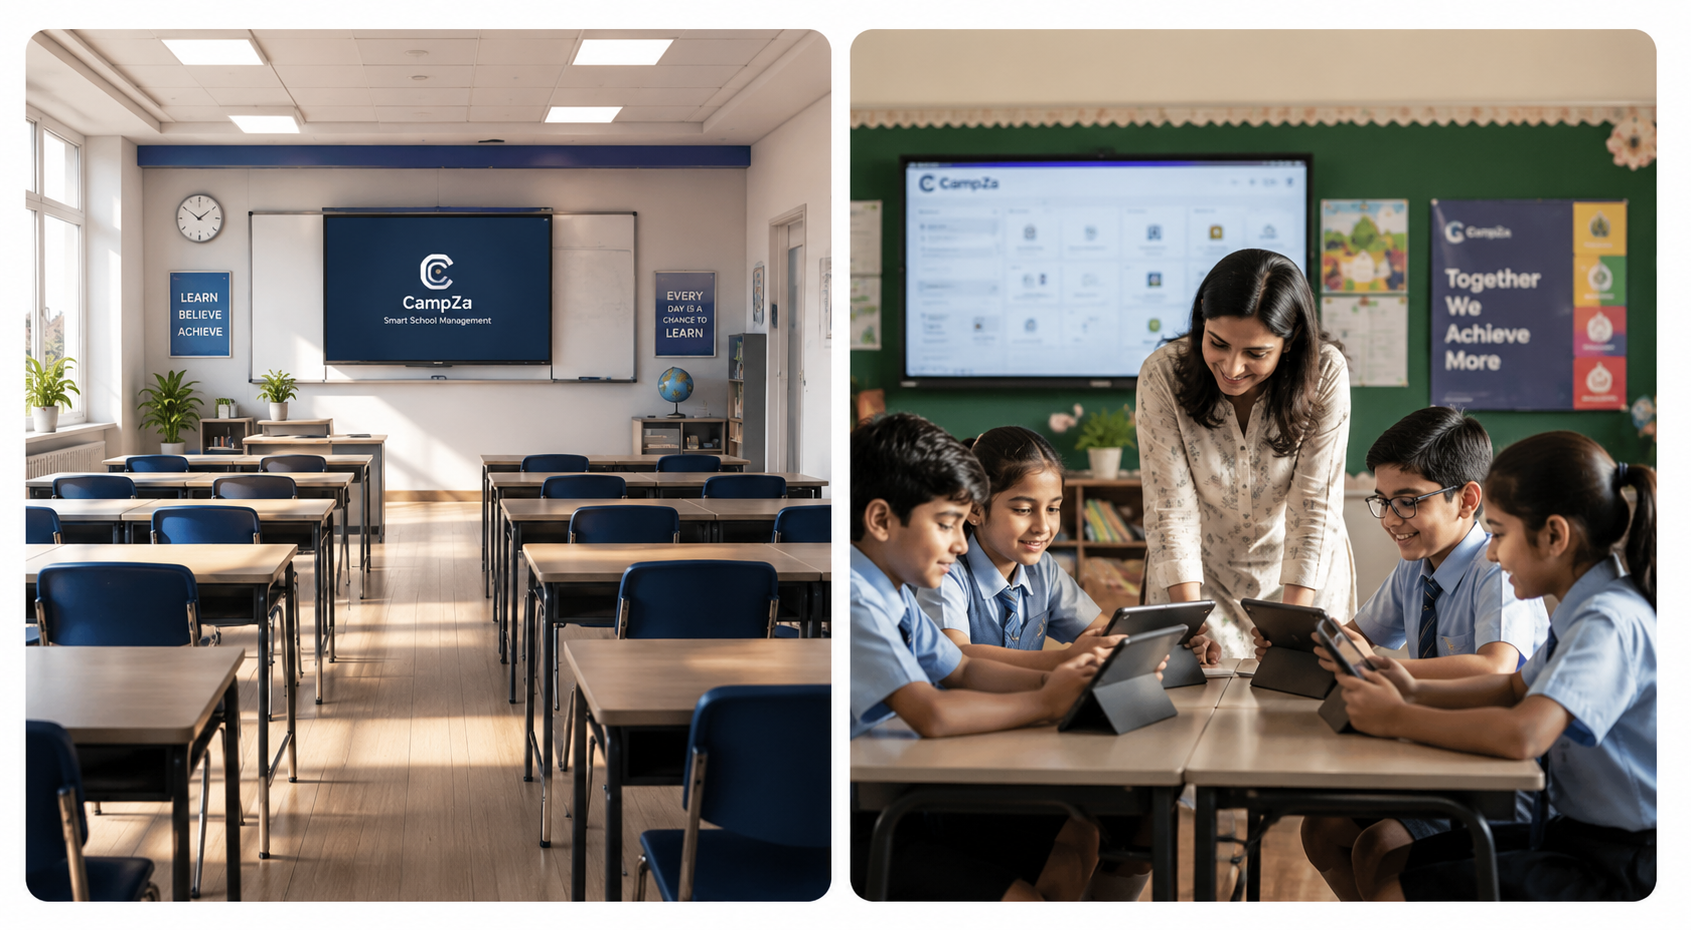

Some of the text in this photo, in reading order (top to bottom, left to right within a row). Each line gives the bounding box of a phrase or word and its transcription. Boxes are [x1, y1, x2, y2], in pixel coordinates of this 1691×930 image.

[939, 176, 999, 192] CampZa
[1445, 268, 1542, 294] Together
[181, 292, 218, 303] LEARN
[667, 291, 703, 301] EVERY
[403, 295, 472, 314] CampZa
[668, 305, 703, 313] DAY IS A
[1445, 296, 1482, 316] We
[178, 309, 222, 320] BELIEVE
[663, 316, 708, 324] CHANCE TO
[383, 316, 492, 326] Smart School Management
[178, 326, 223, 337] ACHIEVE
[666, 328, 703, 338] LEARN
[1445, 323, 1531, 344] Achieve
[1445, 350, 1501, 371] More
